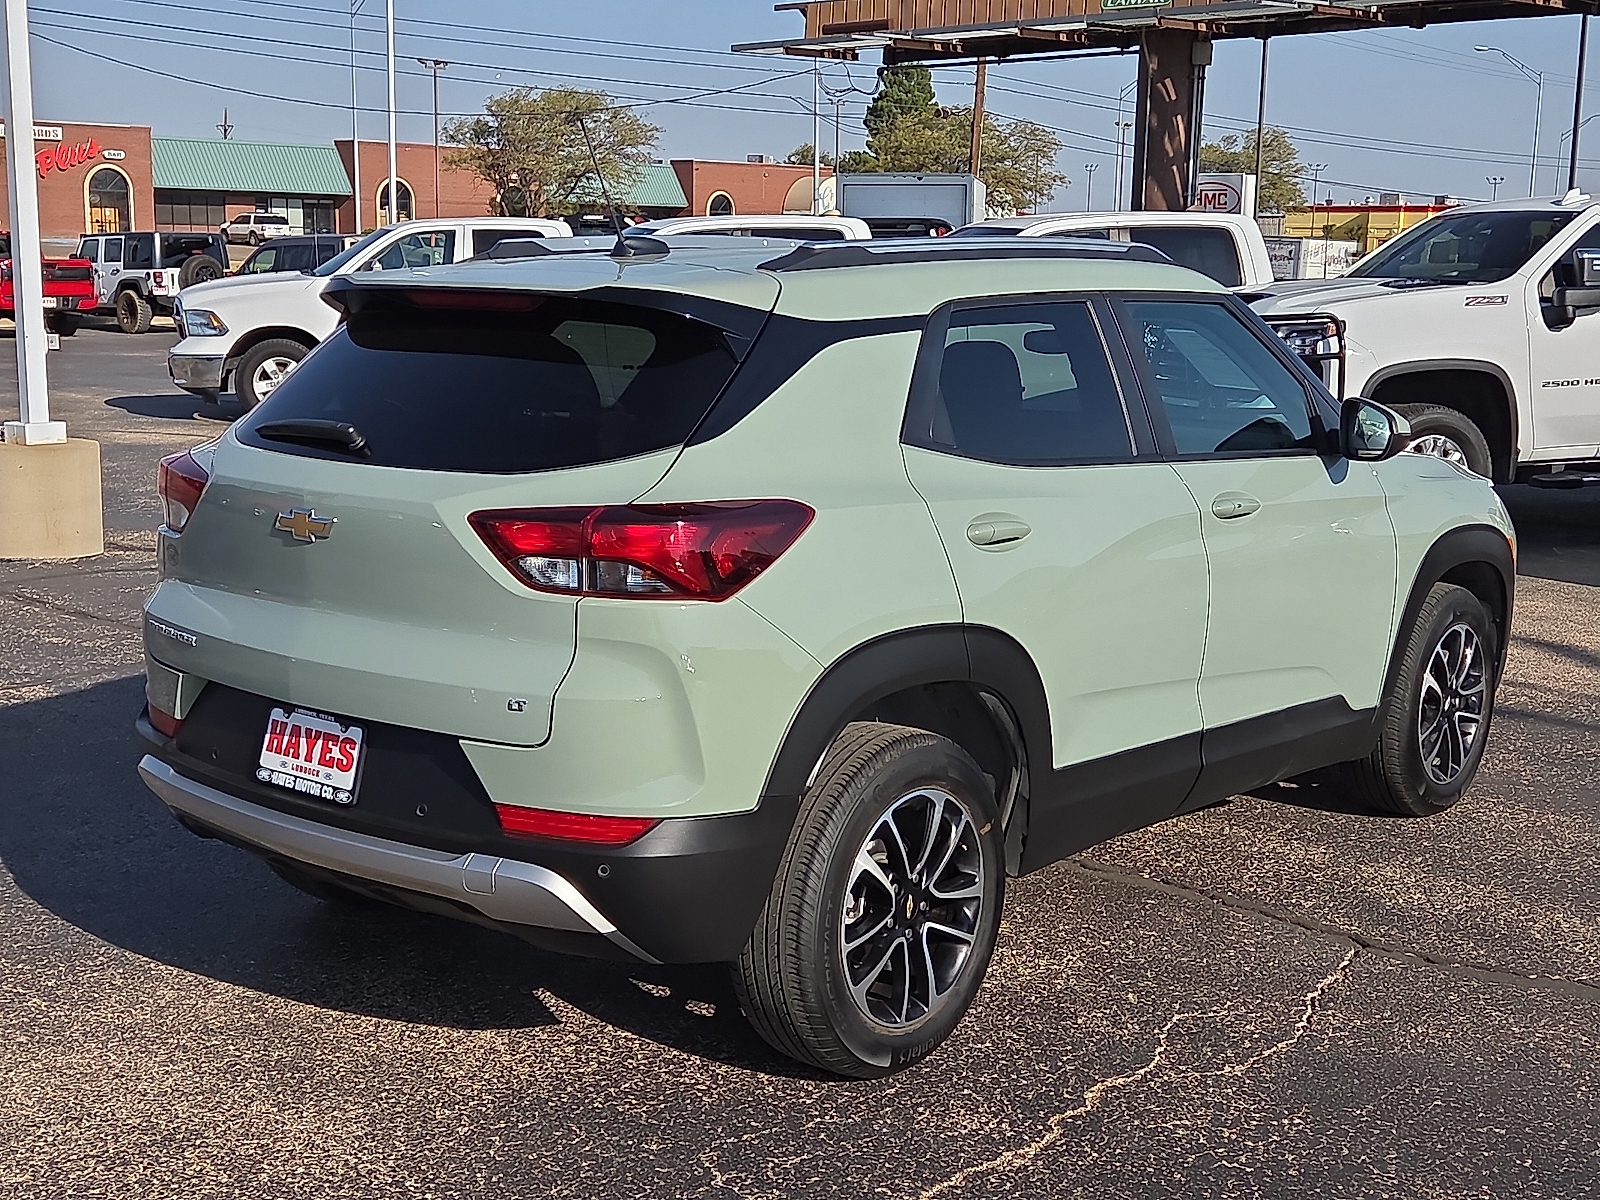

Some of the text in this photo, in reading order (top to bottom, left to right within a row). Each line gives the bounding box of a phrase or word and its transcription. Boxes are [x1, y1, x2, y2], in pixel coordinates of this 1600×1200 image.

[1541, 380, 1580, 388] 2500
[265, 718, 357, 773] HAYES
[290, 763, 321, 778] LUBBOCK
[271, 771, 296, 789] HAYES
[295, 778, 322, 797] MOTOR
